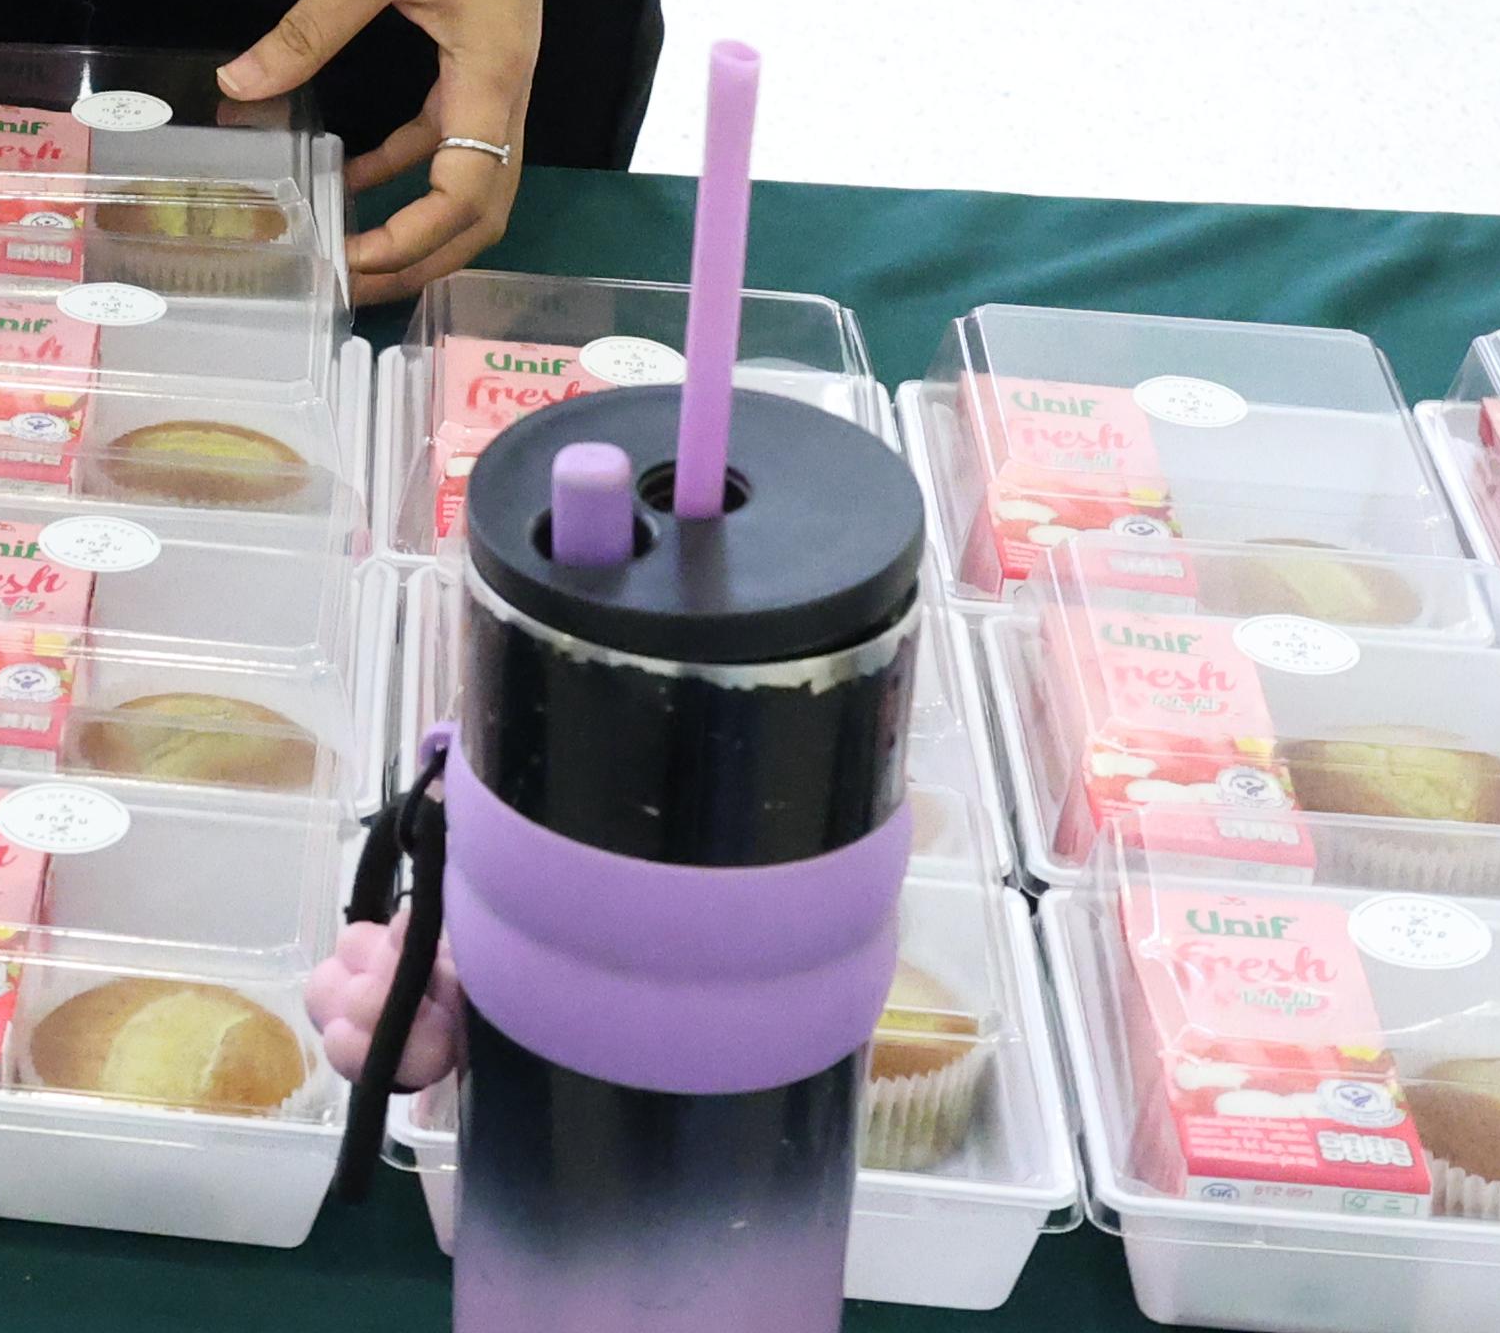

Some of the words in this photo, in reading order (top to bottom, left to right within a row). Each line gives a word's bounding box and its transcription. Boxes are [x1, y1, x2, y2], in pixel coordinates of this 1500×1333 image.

[484, 351, 576, 375] Unif
[1011, 390, 1101, 418] Unif
[1100, 623, 1202, 655] Unif
[1187, 908, 1299, 939] Unif
[1175, 939, 1338, 987] fresh
